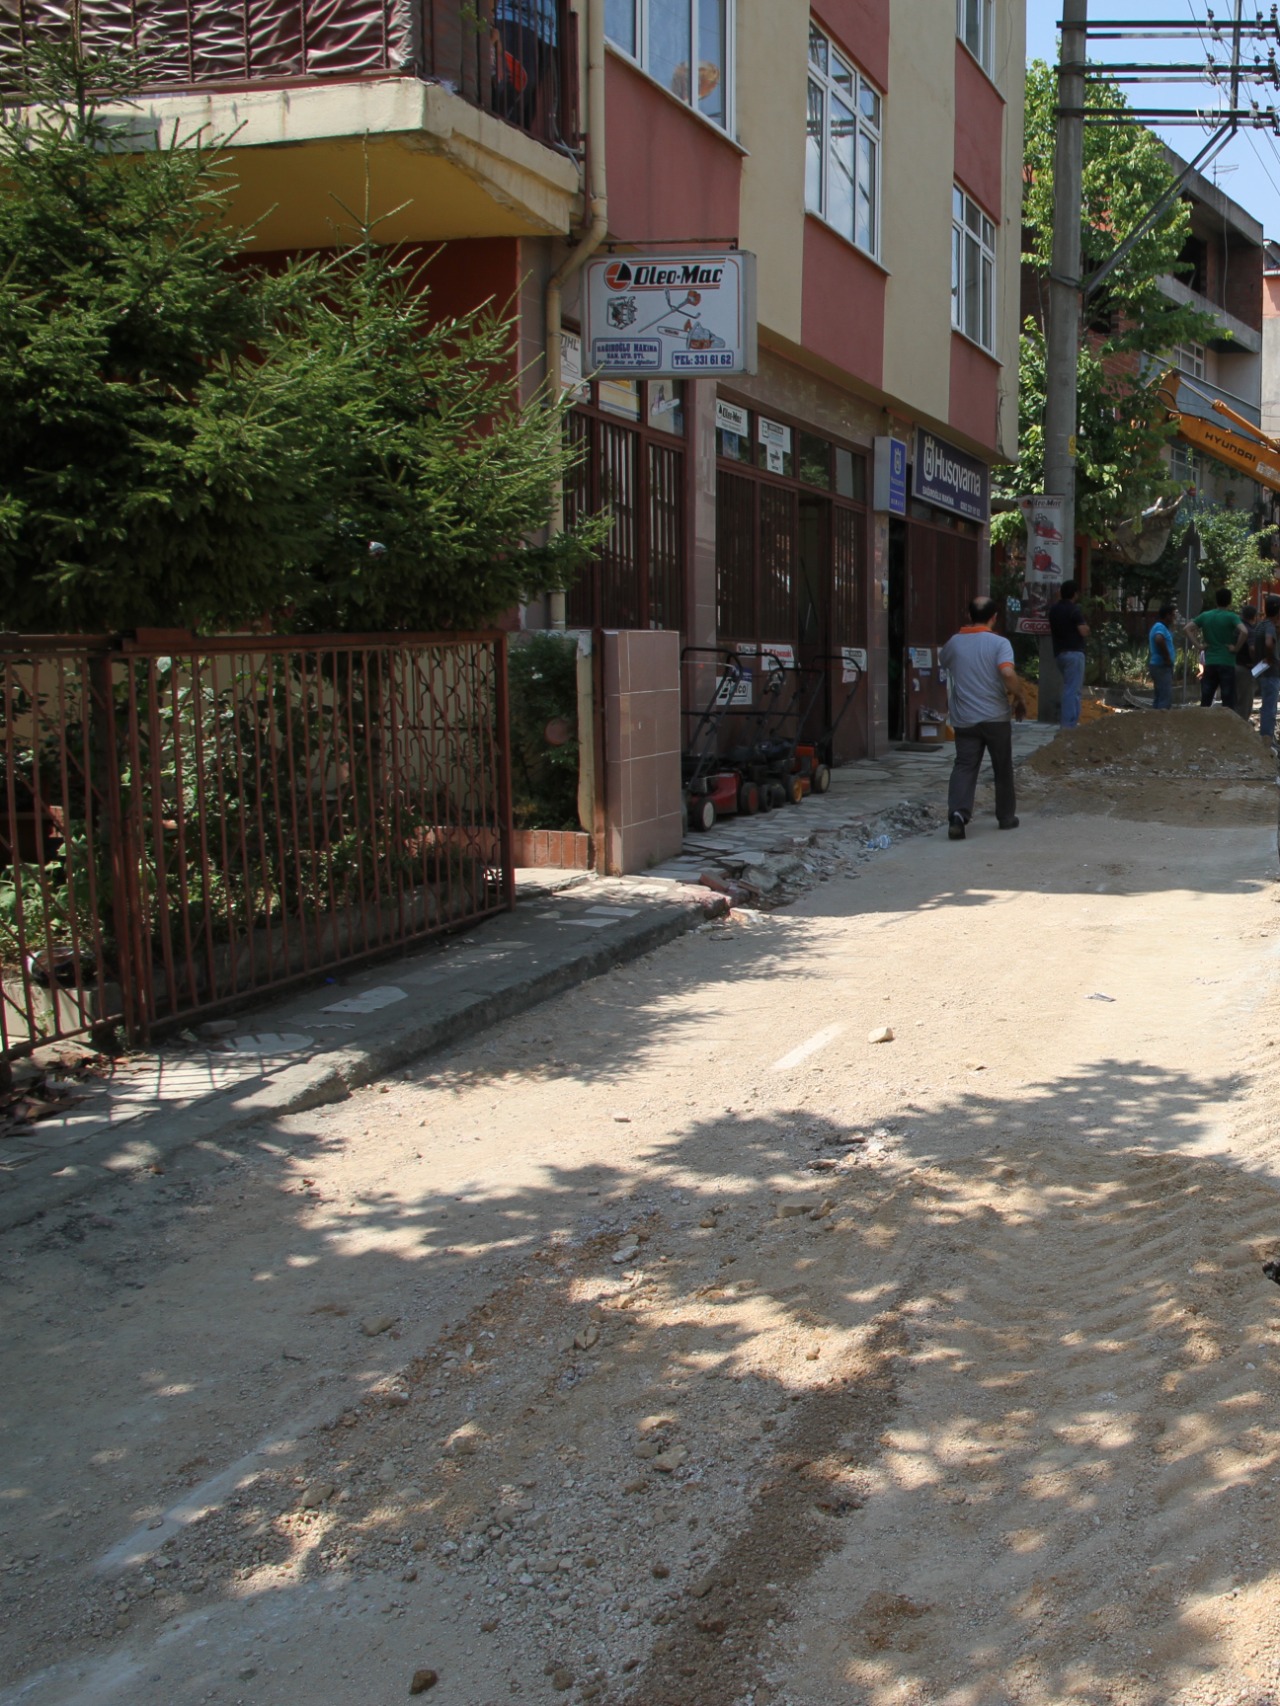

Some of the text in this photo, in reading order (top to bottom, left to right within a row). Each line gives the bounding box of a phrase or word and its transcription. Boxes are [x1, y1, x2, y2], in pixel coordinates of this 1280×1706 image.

[633, 264, 723, 286] Oleo-Mac
[561, 334, 579, 352] TIHL
[675, 354, 732, 365] TEL: 331 61 62
[1204, 432, 1257, 462] HYUNDAI
[934, 446, 982, 498] Husqvarna
